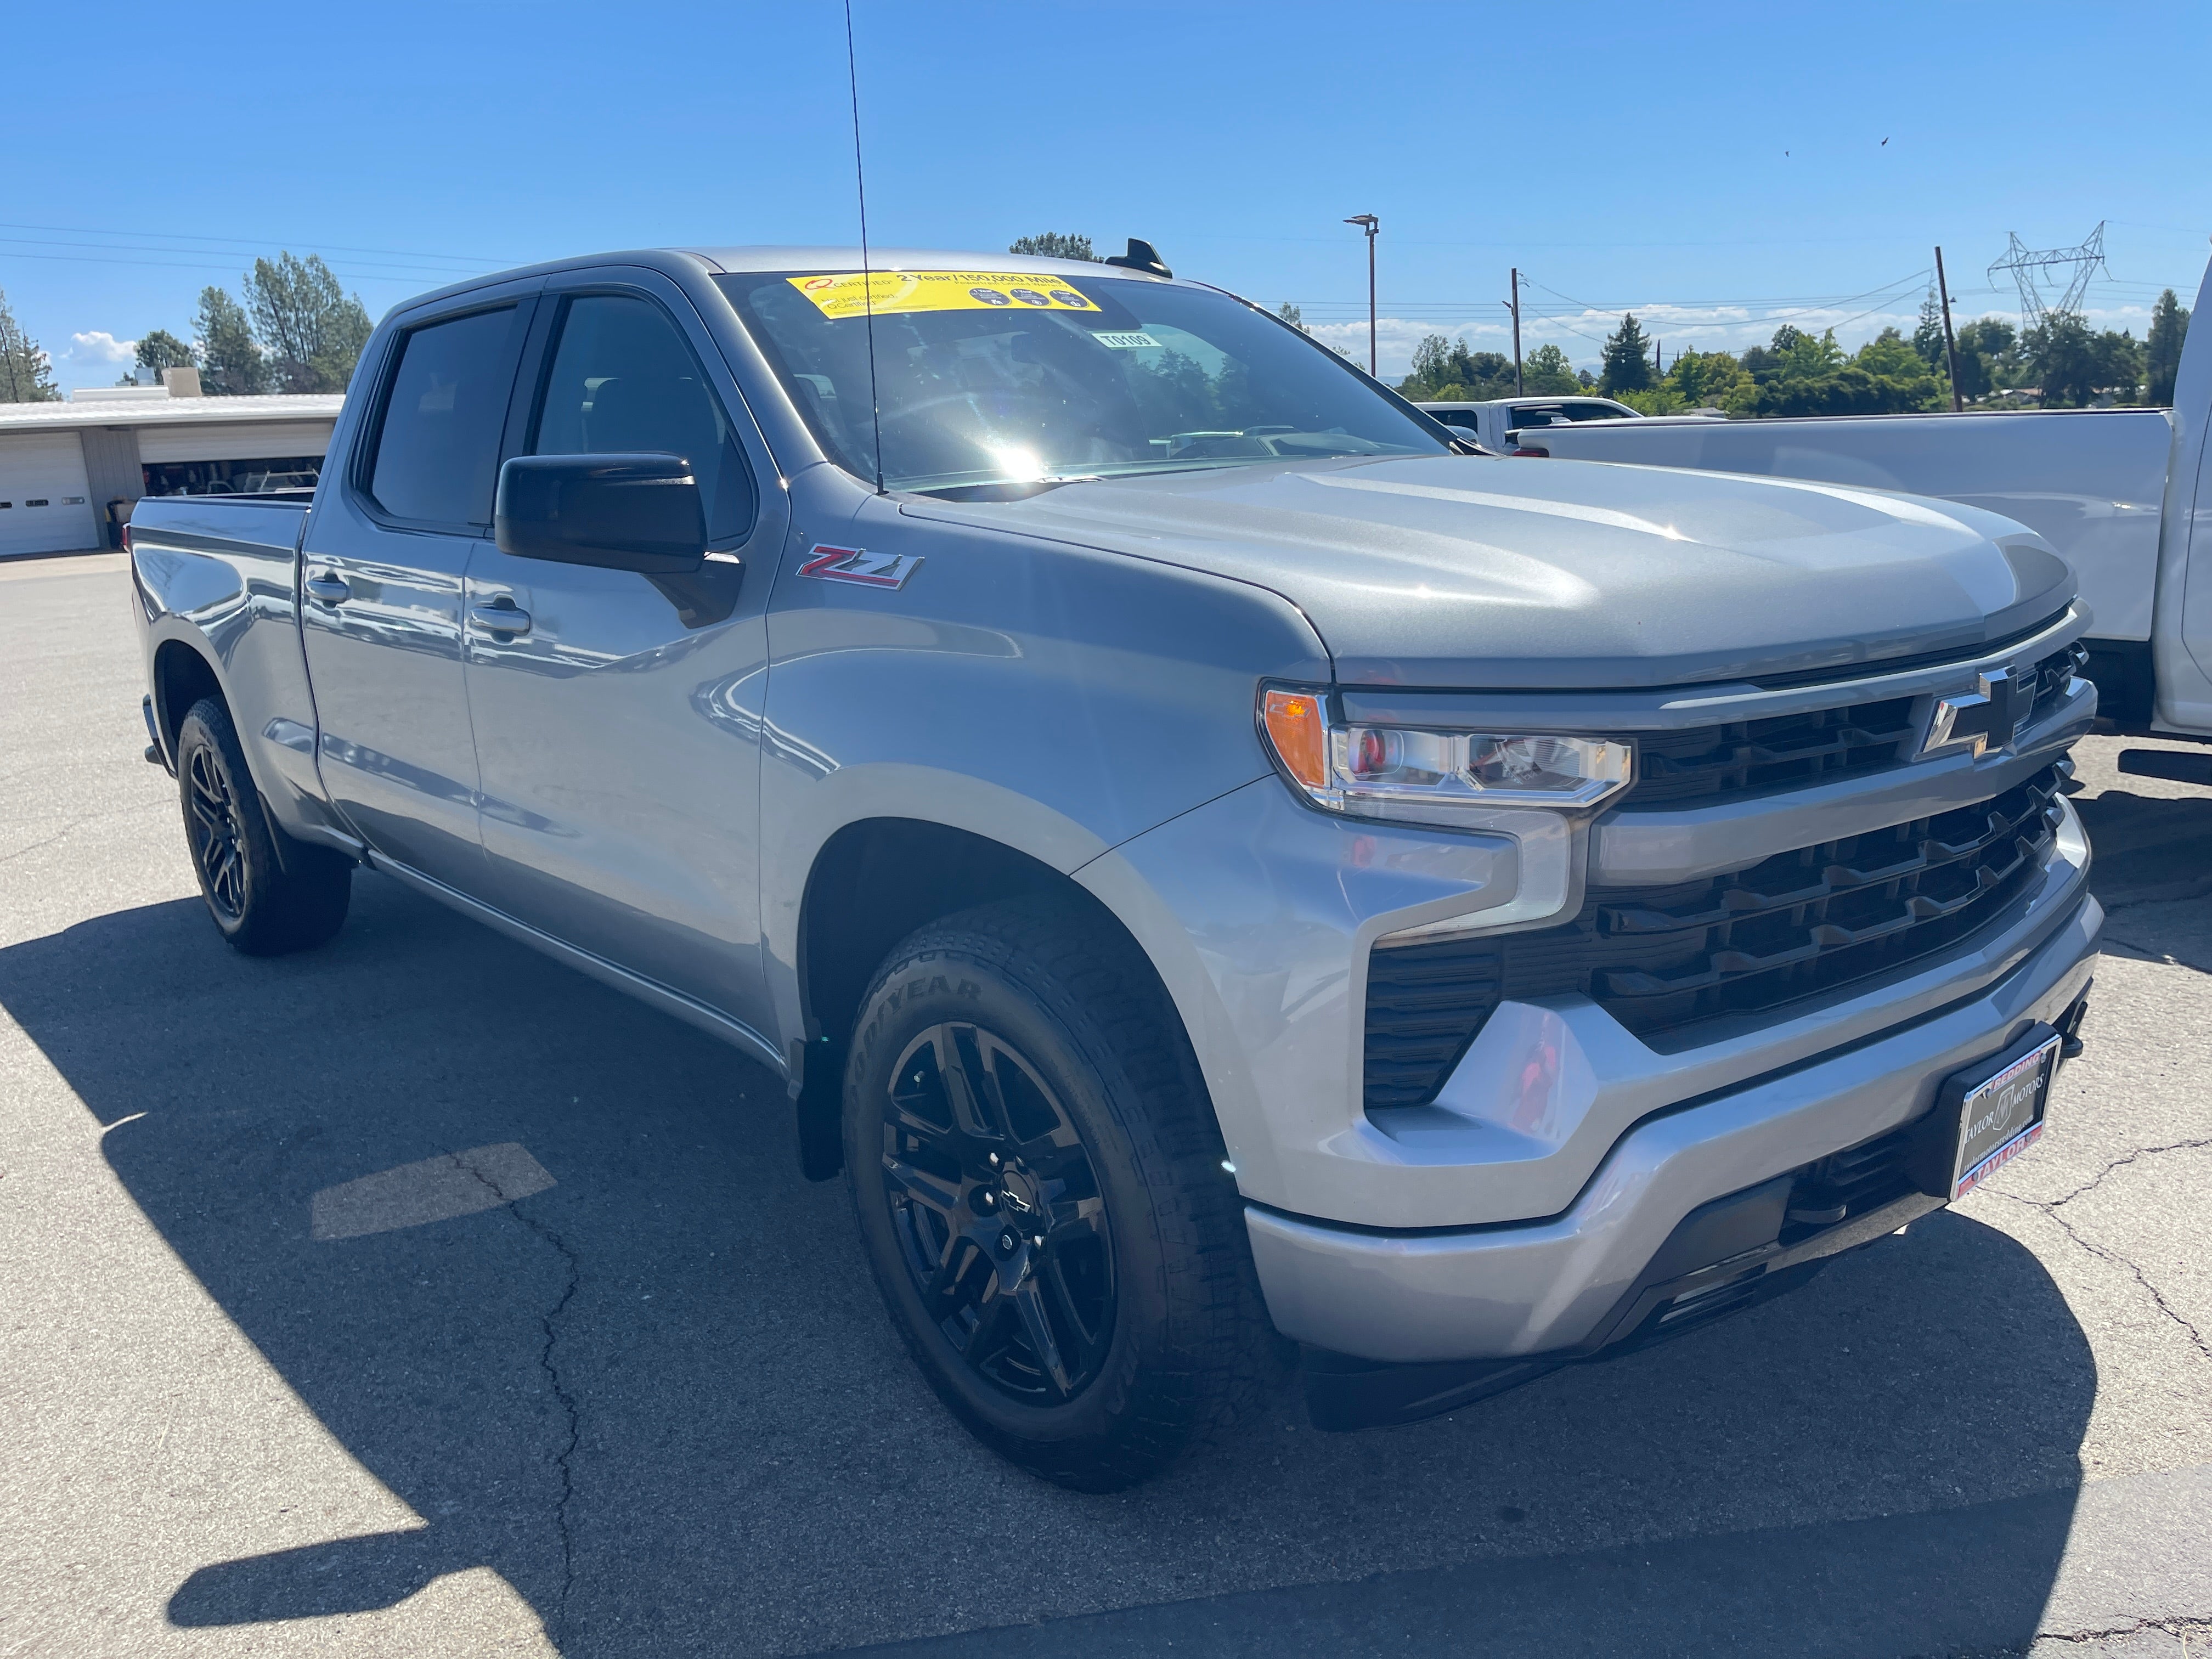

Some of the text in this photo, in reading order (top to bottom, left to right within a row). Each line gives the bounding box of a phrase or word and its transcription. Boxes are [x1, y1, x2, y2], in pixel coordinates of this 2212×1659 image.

[795, 543, 925, 591] Z71
[1993, 1052, 2041, 1090] REDDING
[1964, 1111, 1994, 1144] TAYLOR
[2012, 1073, 2044, 1108] MOTORS
[1963, 1114, 2034, 1173] taylormotorsredding.com
[1977, 1136, 2026, 1182] TAYLOR
